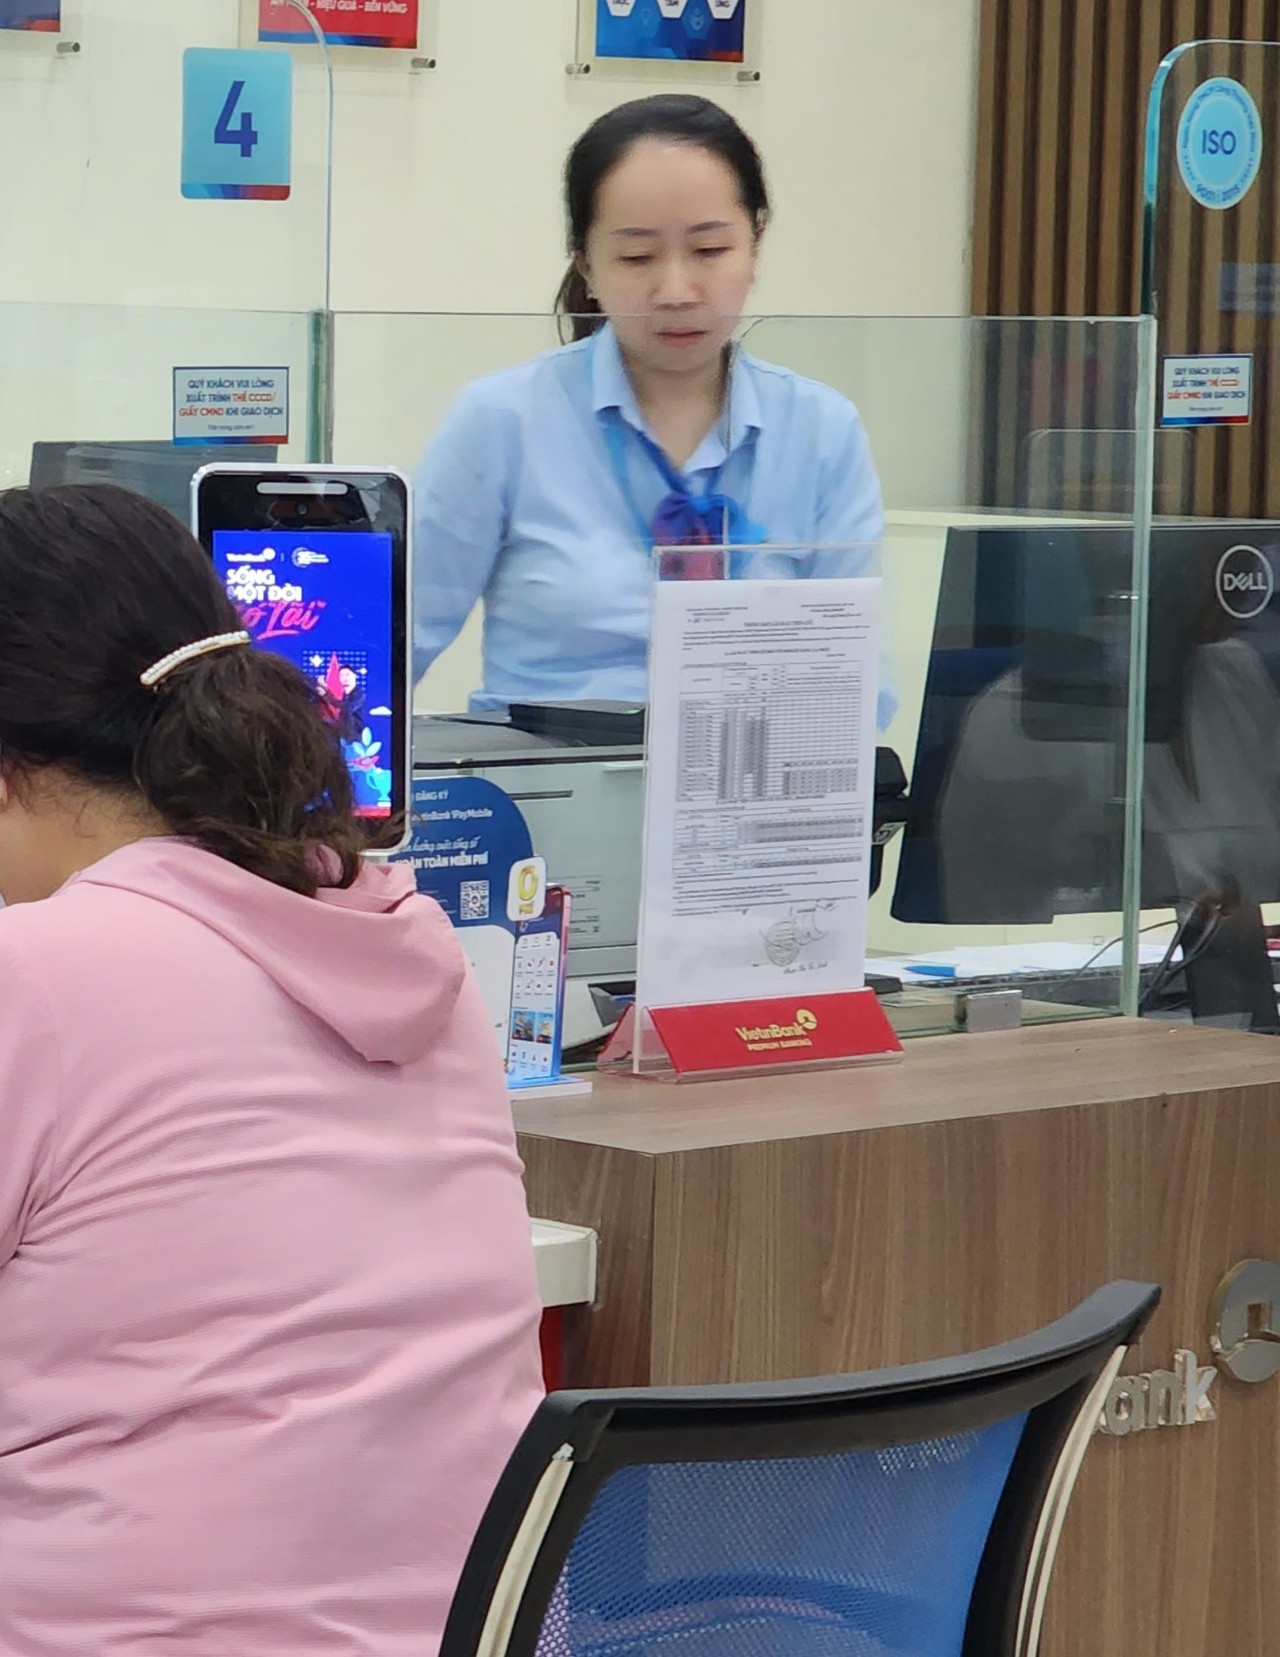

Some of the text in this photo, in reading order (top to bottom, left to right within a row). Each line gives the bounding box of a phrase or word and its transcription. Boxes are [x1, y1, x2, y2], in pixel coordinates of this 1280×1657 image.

[214, 81, 258, 157] 4
[1202, 129, 1237, 155] ISO
[188, 378, 204, 389] QUÝ
[206, 378, 234, 389] KHÁCH
[252, 377, 275, 389] LÒNG
[225, 407, 239, 416] KHI
[241, 407, 262, 416] GIAO
[226, 564, 276, 586] SỐNG
[1223, 572, 1269, 591] DELL
[268, 582, 302, 602] ĐỜI
[423, 854, 449, 868] TOÀN
[450, 850, 472, 867] MIỄN
[734, 1022, 807, 1041] VietinBank
[1093, 1348, 1218, 1436] ank
